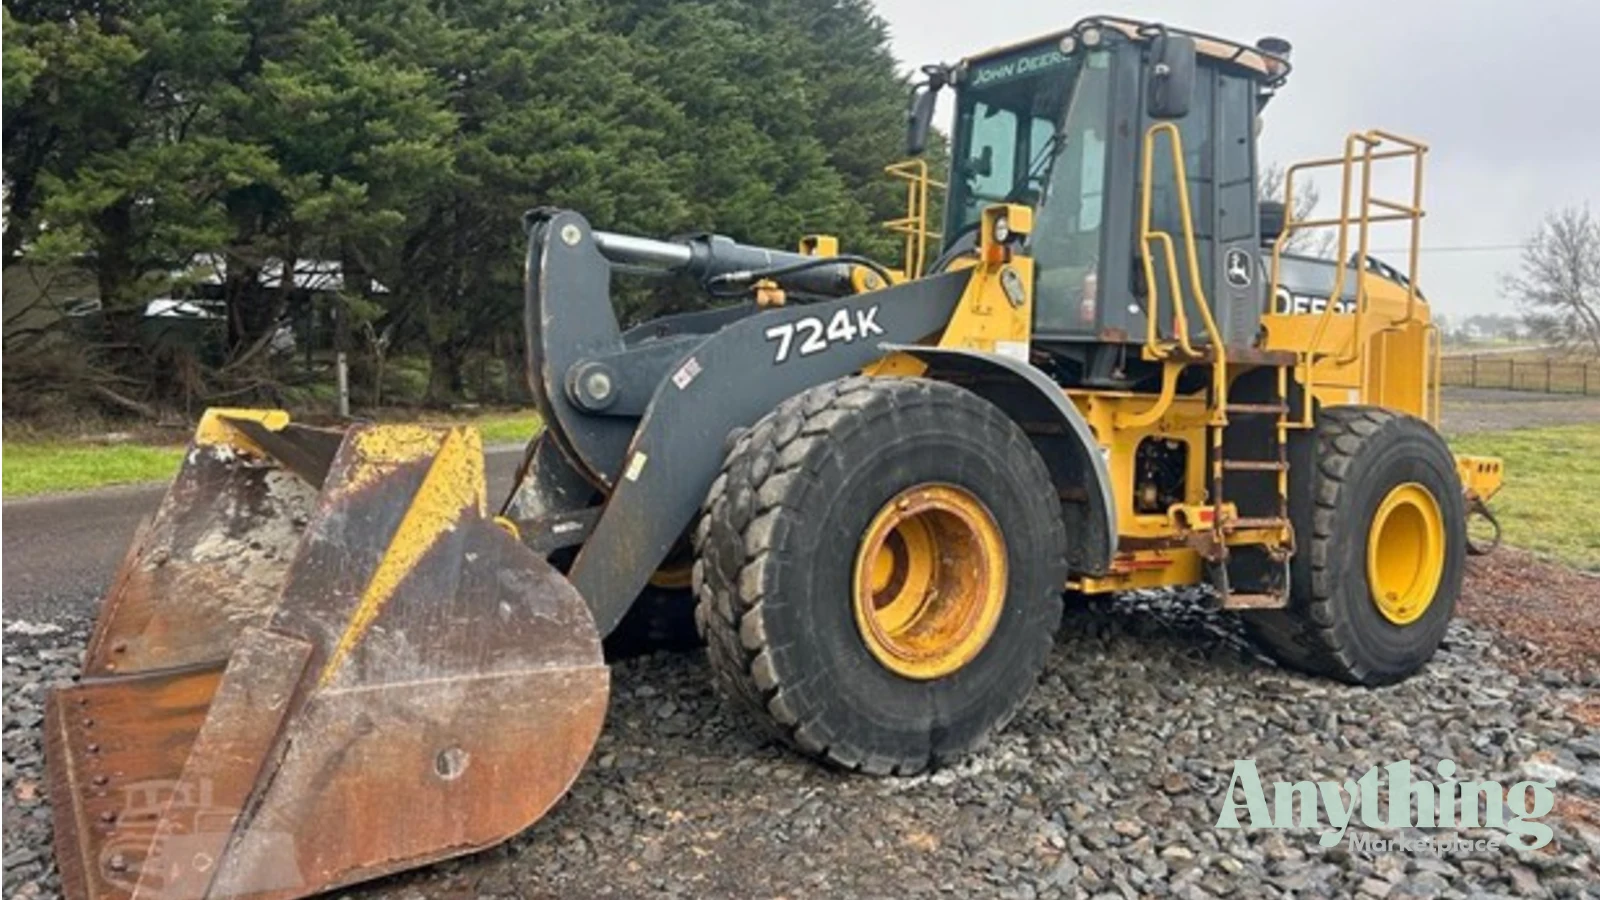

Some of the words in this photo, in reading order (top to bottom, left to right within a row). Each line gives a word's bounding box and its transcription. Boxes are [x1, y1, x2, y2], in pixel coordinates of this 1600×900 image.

[972, 63, 1014, 86] JOHN
[1016, 51, 1071, 74] DEER
[765, 305, 884, 362] 724K
